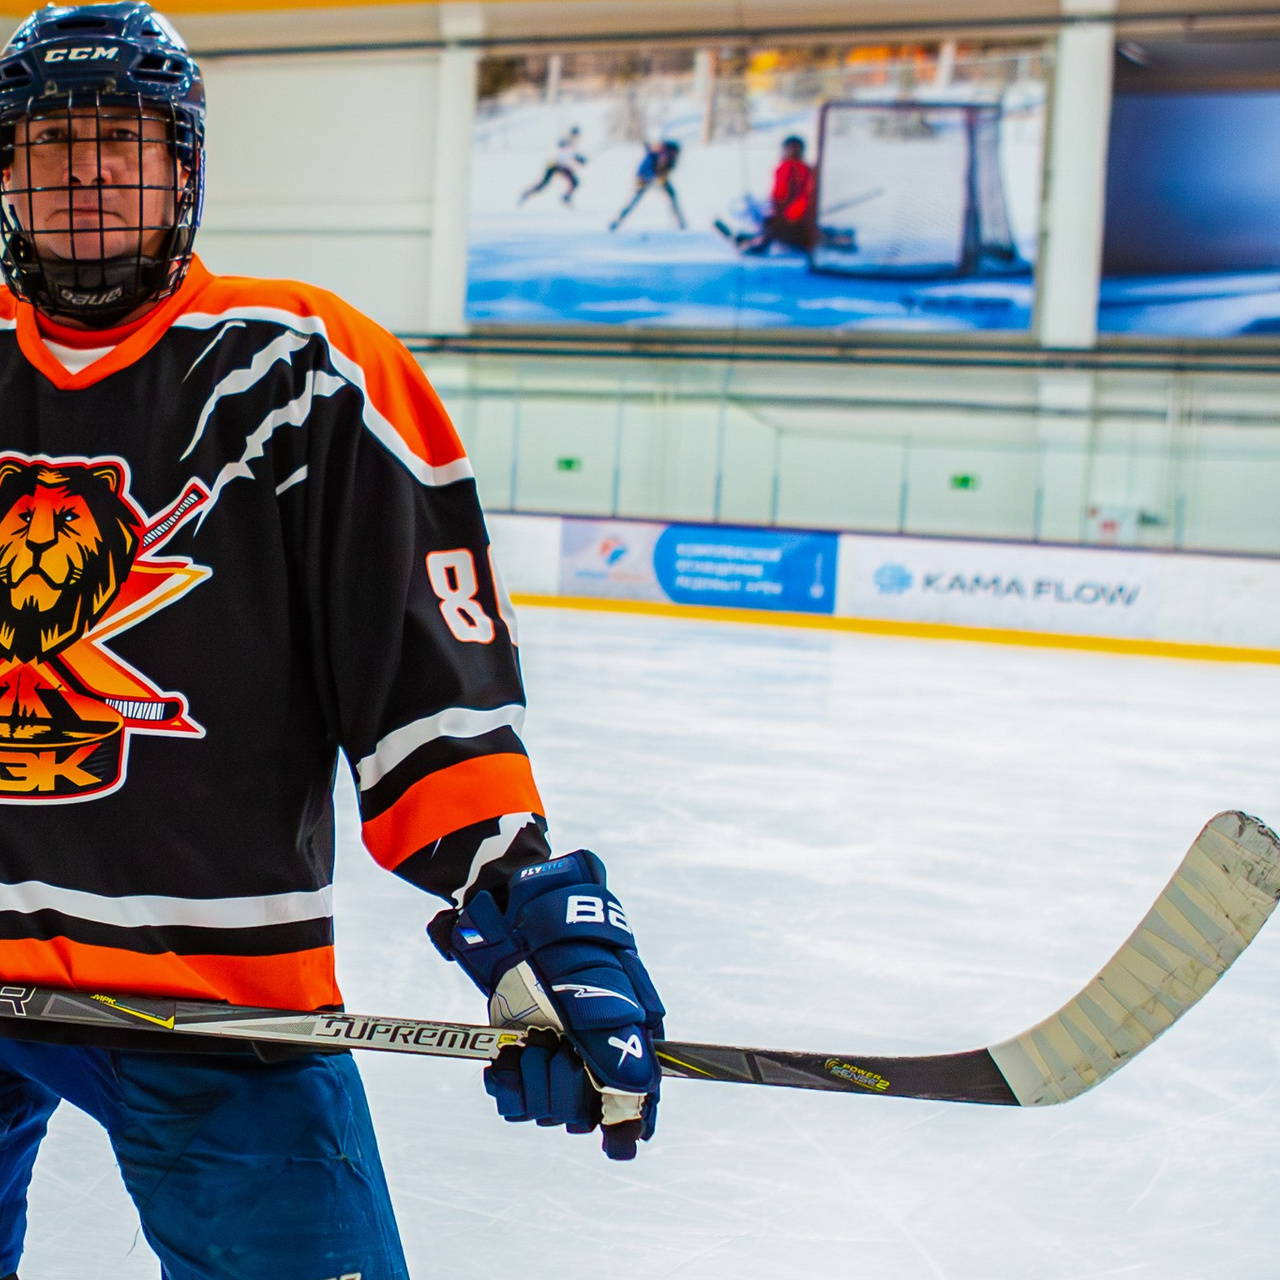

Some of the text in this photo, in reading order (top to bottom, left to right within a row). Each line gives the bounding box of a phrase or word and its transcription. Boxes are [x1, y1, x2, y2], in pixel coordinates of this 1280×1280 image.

[44, 46, 119, 62] CCM
[922, 572, 1140, 606] KAMA FLOW
[316, 1015, 496, 1052] SUPREME
[842, 1063, 882, 1081] POWER
